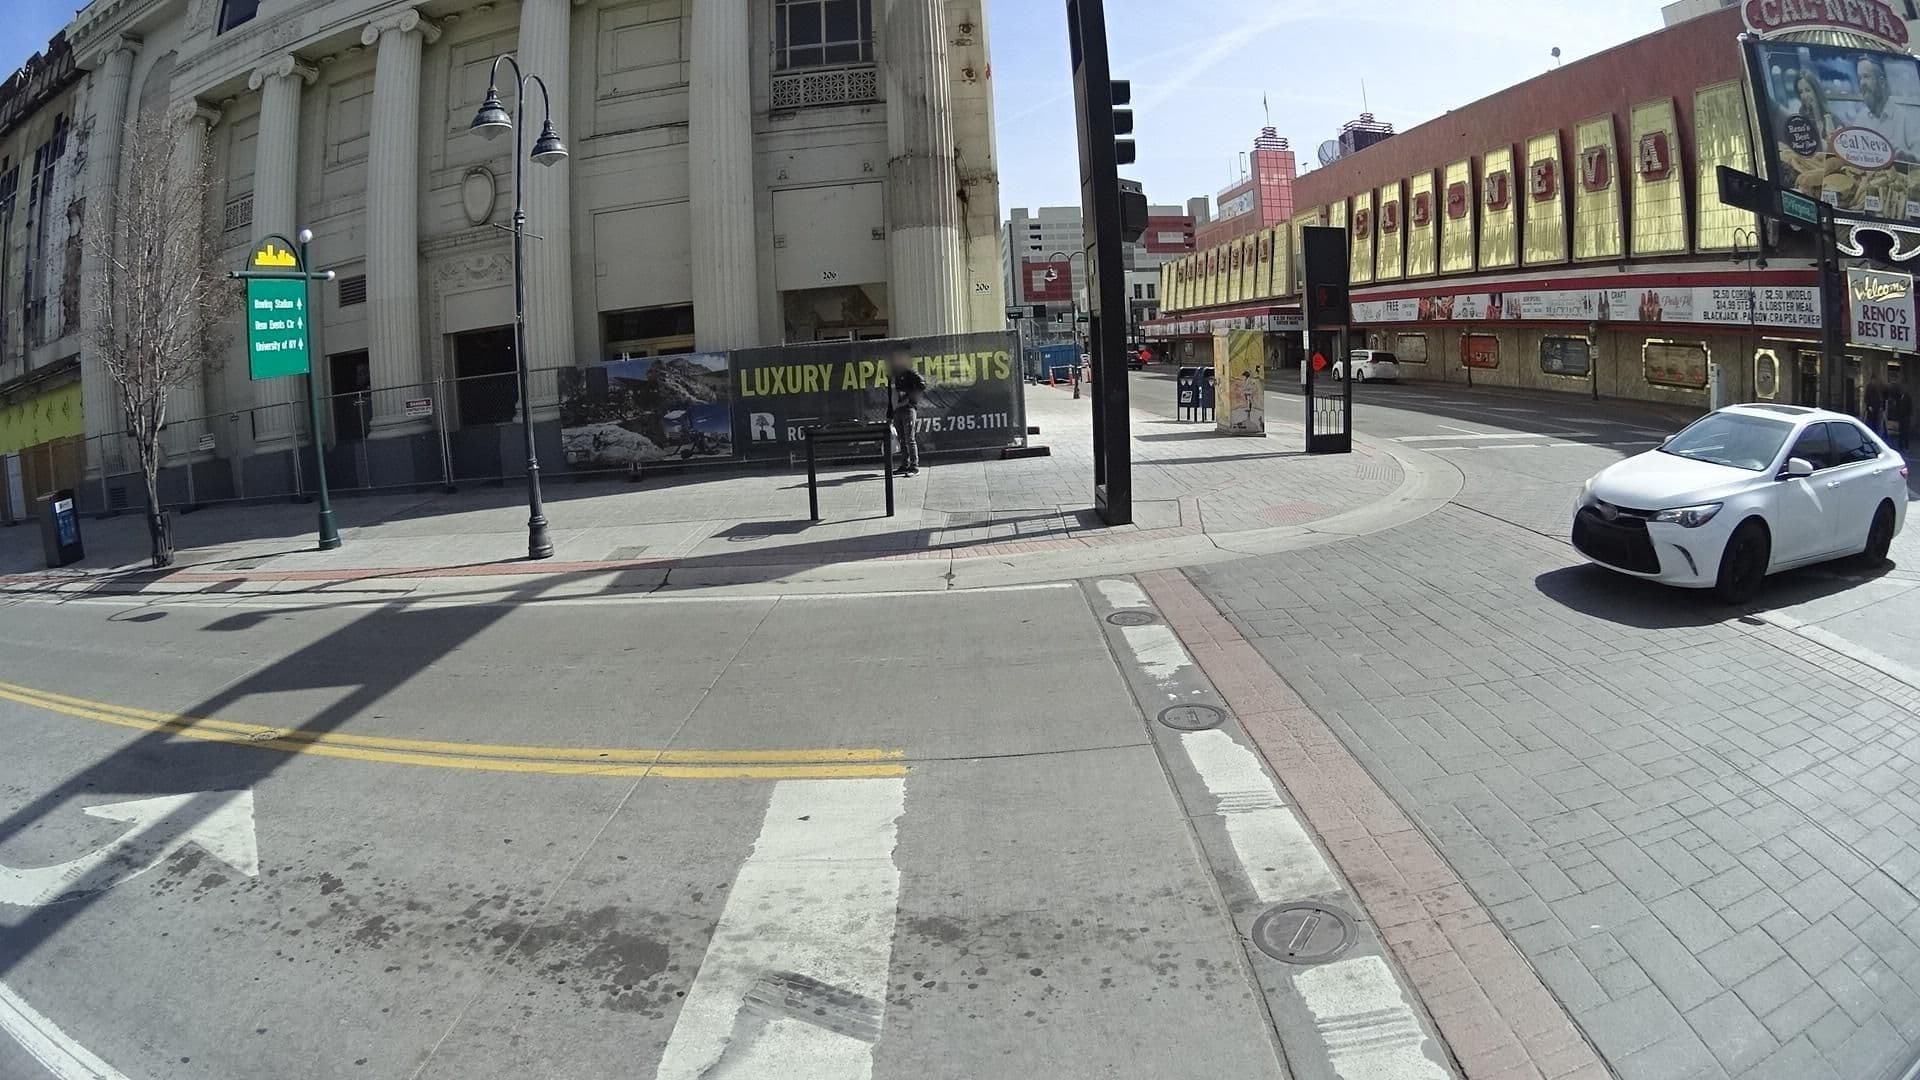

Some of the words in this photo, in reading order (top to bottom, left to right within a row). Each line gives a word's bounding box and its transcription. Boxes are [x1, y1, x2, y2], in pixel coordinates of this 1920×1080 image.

[1840, 134, 1859, 150] Cal
[1861, 135, 1889, 152] Neva
[1786, 290, 1812, 300] MODELO
[1851, 276, 1909, 301] Welcome
[1386, 301, 1399, 312] FREE
[1765, 301, 1794, 311] LOBSTER
[1796, 302, 1814, 312] MEAL
[1862, 304, 1907, 324] RENO'S
[1799, 314, 1821, 325] POKER
[1857, 320, 1886, 338] BEST
[1890, 324, 1911, 341] BET
[256, 341, 280, 351] University
[282, 340, 287, 349] of
[741, 363, 833, 397] LUXURY
[842, 351, 1011, 390] APATMENTS
[914, 412, 1008, 433] 775.785.1111
